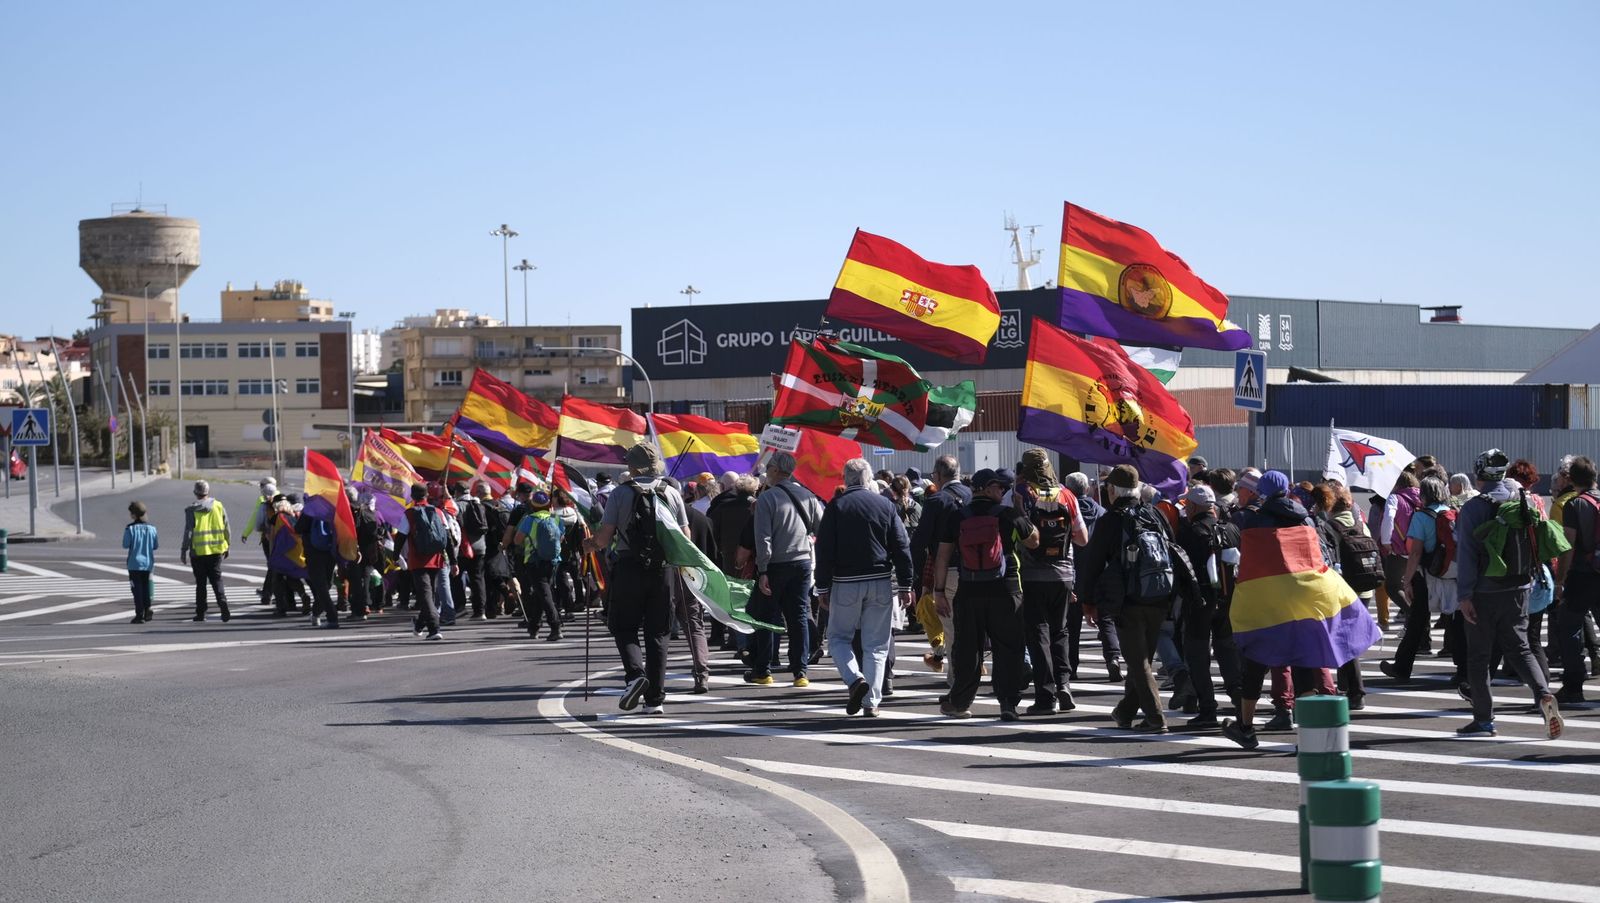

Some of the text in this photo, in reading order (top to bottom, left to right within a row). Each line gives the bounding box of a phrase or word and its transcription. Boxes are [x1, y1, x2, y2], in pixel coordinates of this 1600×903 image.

[1001, 315, 1017, 326] SA
[1281, 320, 1290, 330] SA
[716, 328, 902, 348] GRUPO LOP GUILLE
[1001, 328, 1017, 339] LG
[1281, 332, 1290, 342] LG
